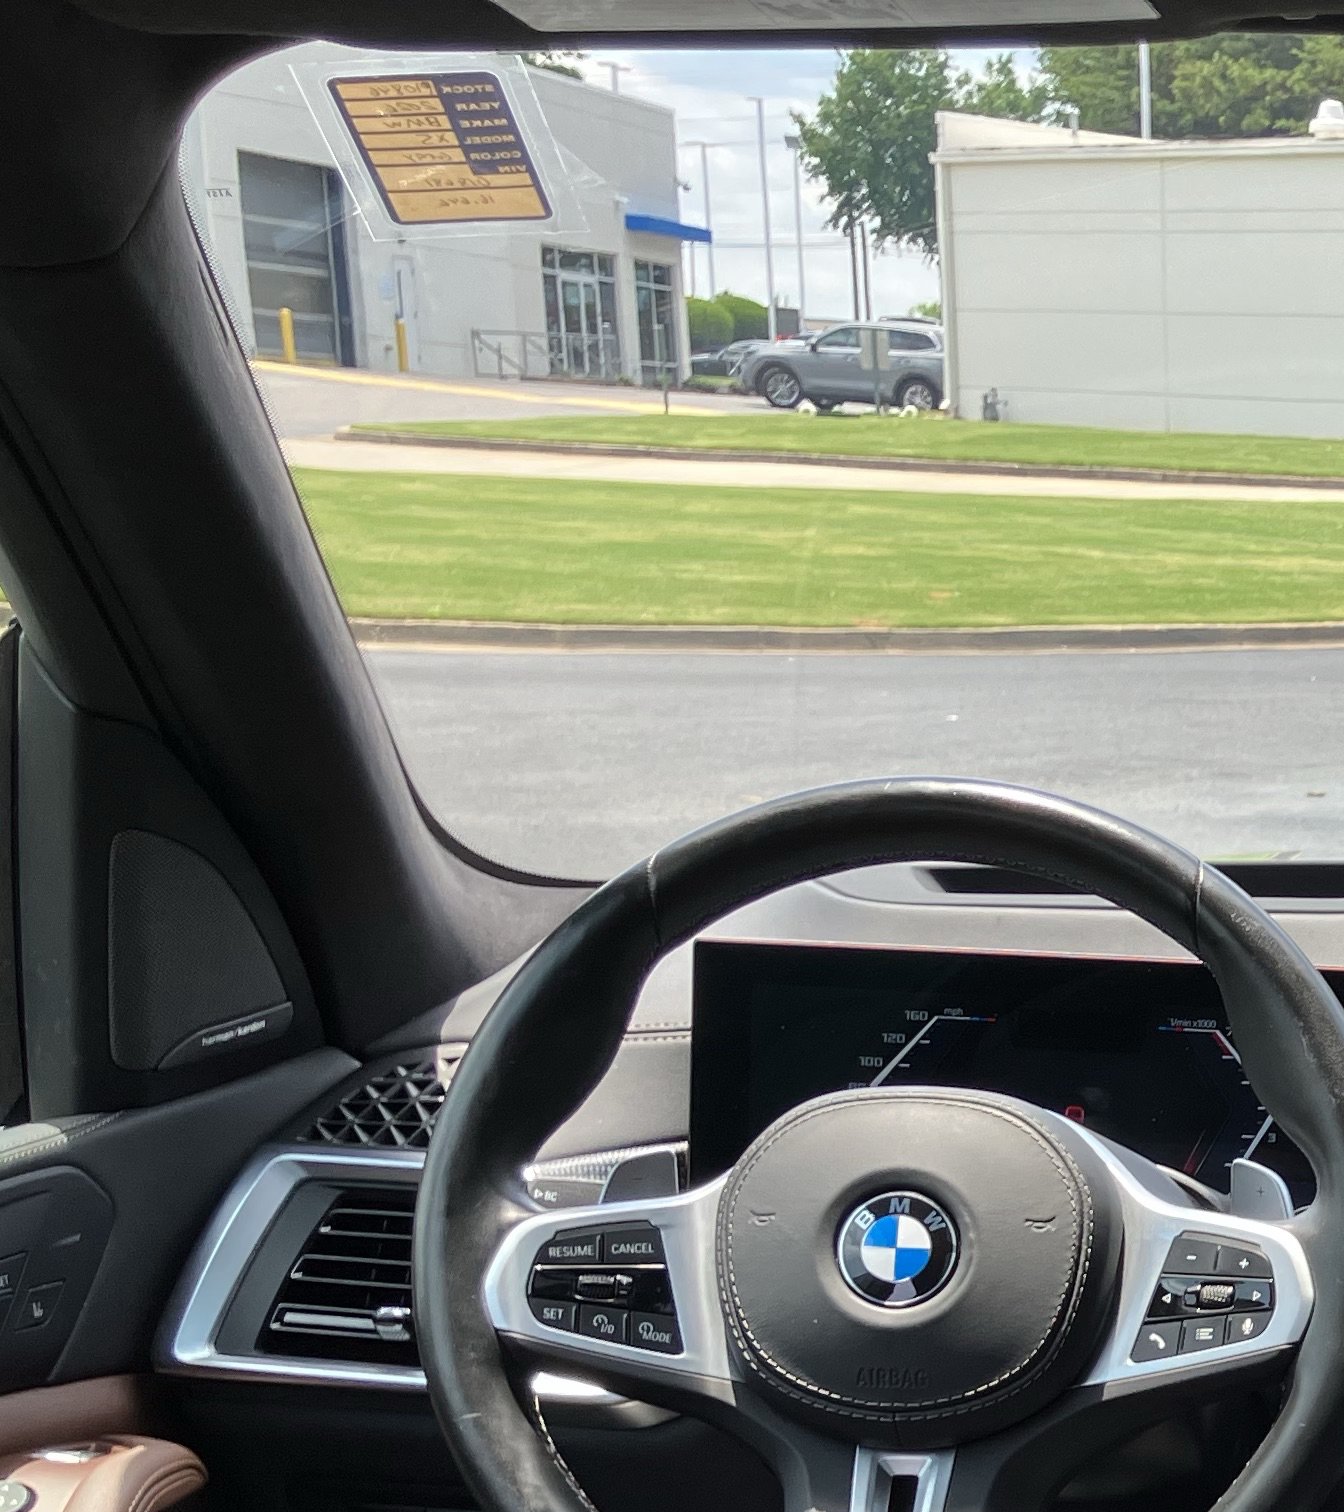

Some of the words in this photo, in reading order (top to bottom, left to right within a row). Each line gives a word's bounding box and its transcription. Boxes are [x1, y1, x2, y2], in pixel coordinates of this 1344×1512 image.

[905, 1010, 929, 1022] 160
[943, 1007, 964, 1018] mph
[882, 1033, 906, 1044] 120
[859, 1056, 883, 1068] 100
[854, 1197, 947, 1233] BMW
[549, 1244, 595, 1258] RESUME
[611, 1242, 654, 1255] CANCEL
[542, 1307, 565, 1321] SET
[642, 1329, 673, 1345] MODE
